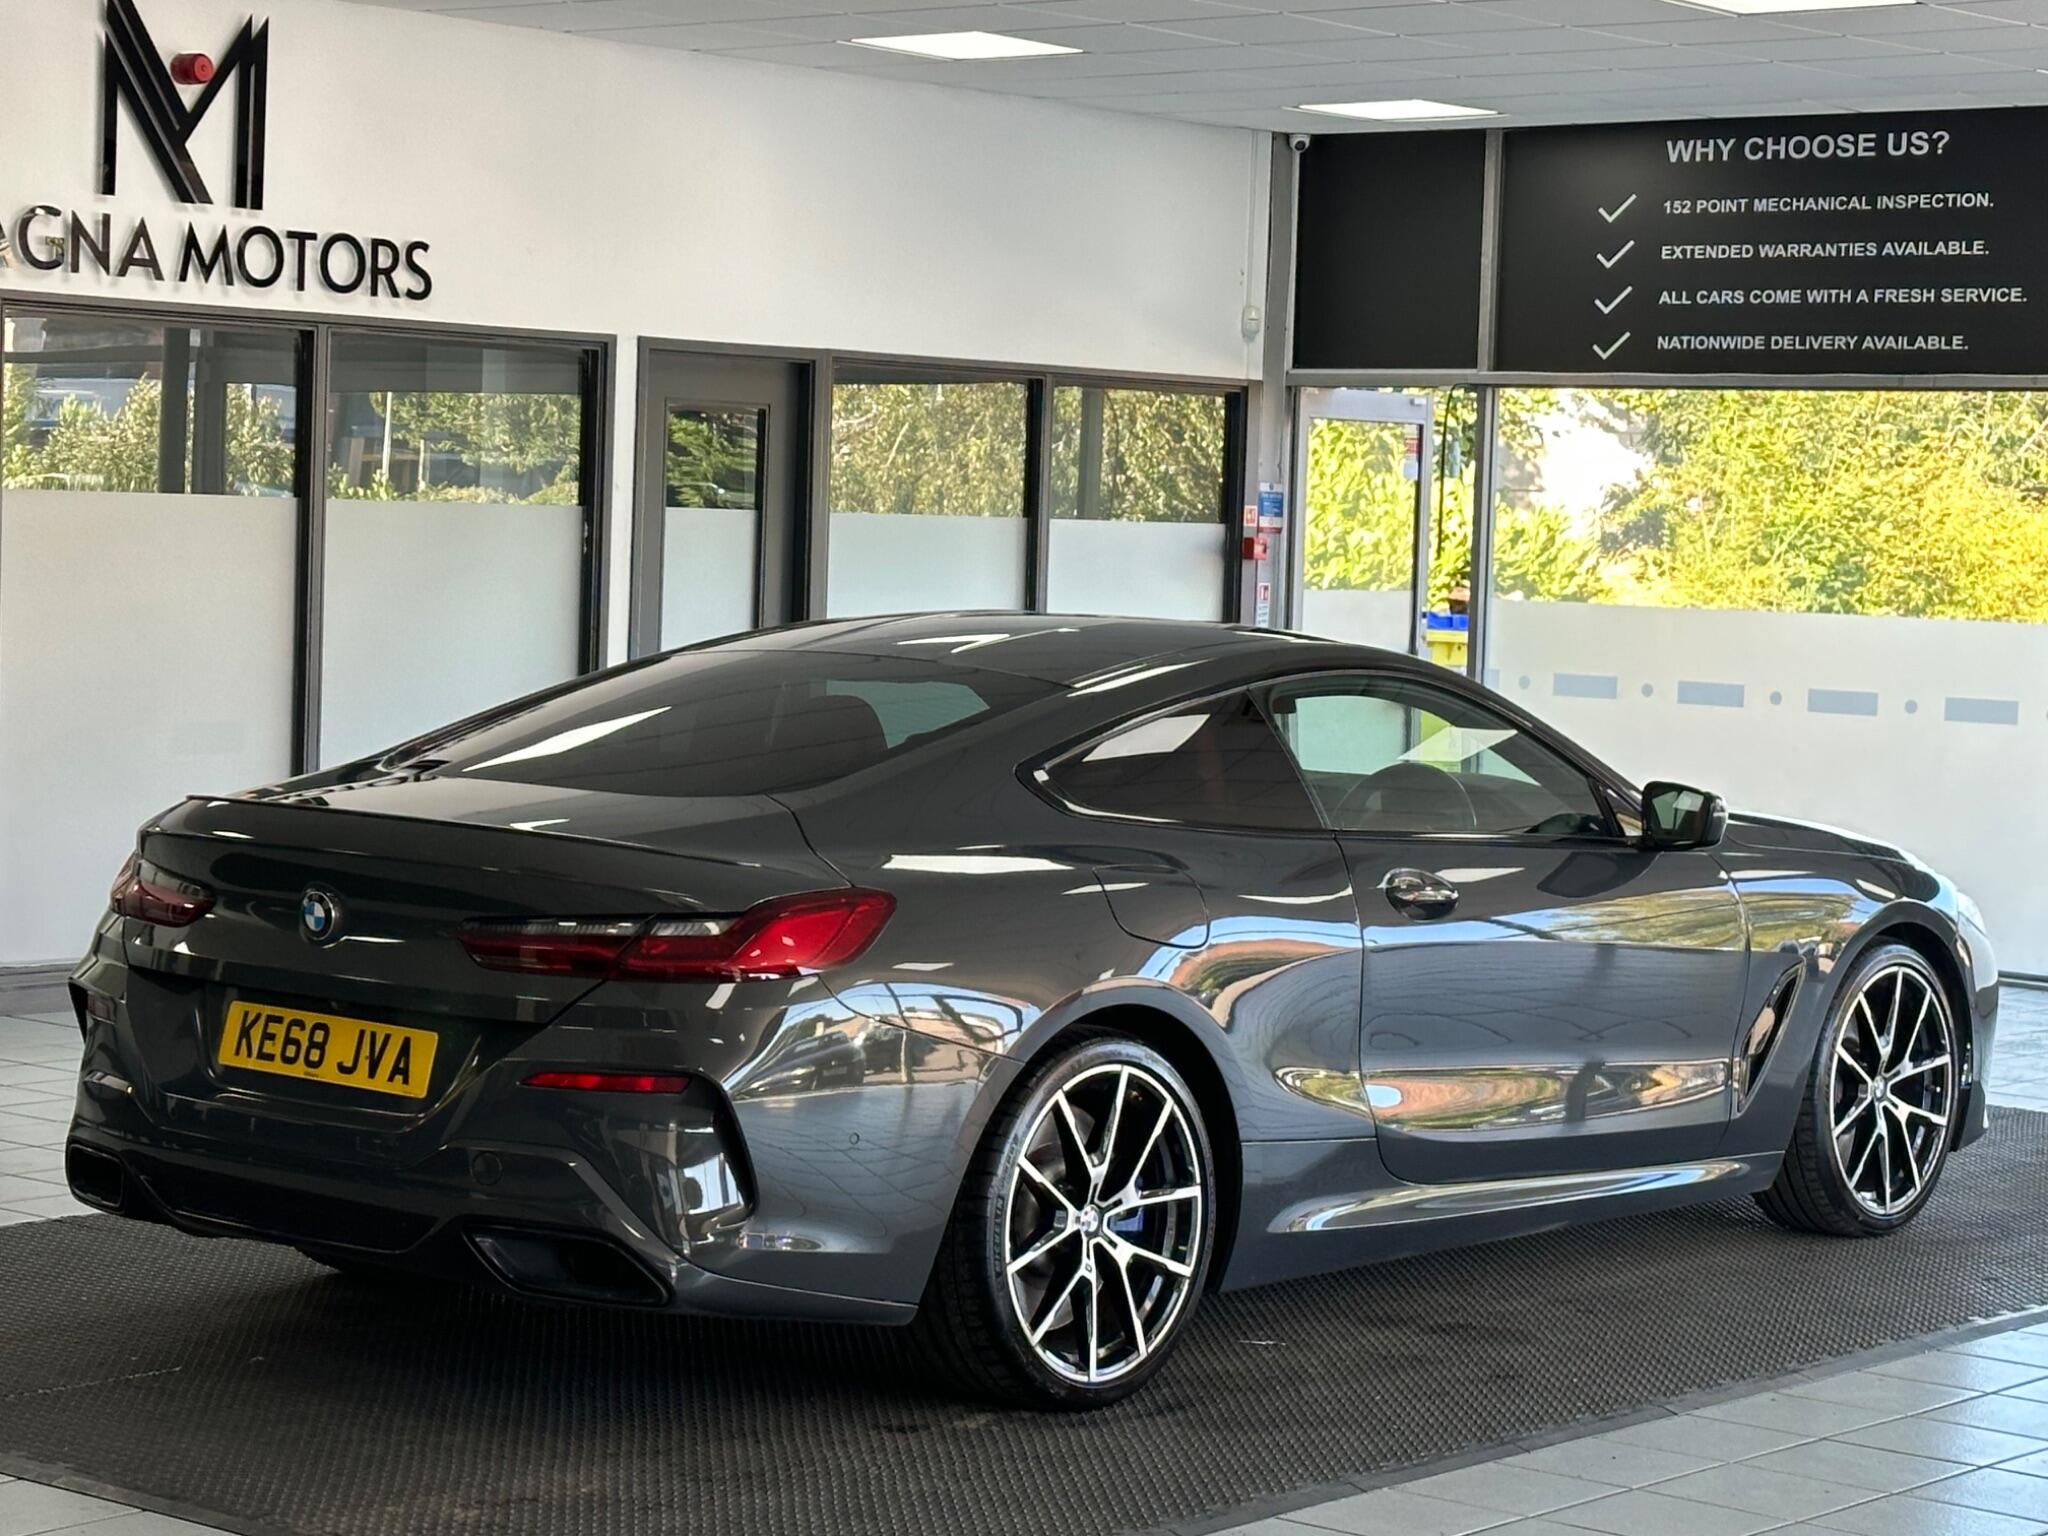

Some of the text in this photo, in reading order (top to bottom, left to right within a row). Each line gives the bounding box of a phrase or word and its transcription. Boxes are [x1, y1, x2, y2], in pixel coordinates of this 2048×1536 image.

[1666, 130, 1950, 164] WHY CHOOSE US?
[1663, 192, 1994, 215] 152 POINT MECHANICAL INSPECTION.
[0, 206, 432, 301] GNA MOTORS
[1660, 240, 1990, 260] EXTENDED WARRANTIES AVAILABLE.
[1658, 287, 2028, 305] ALL CARS COME WITH A FRESH SERVICE.
[1656, 335, 1969, 350] NATIONWIDE DELIVERY AVAILABLE.
[233, 1010, 412, 1086] KE68 JVA
